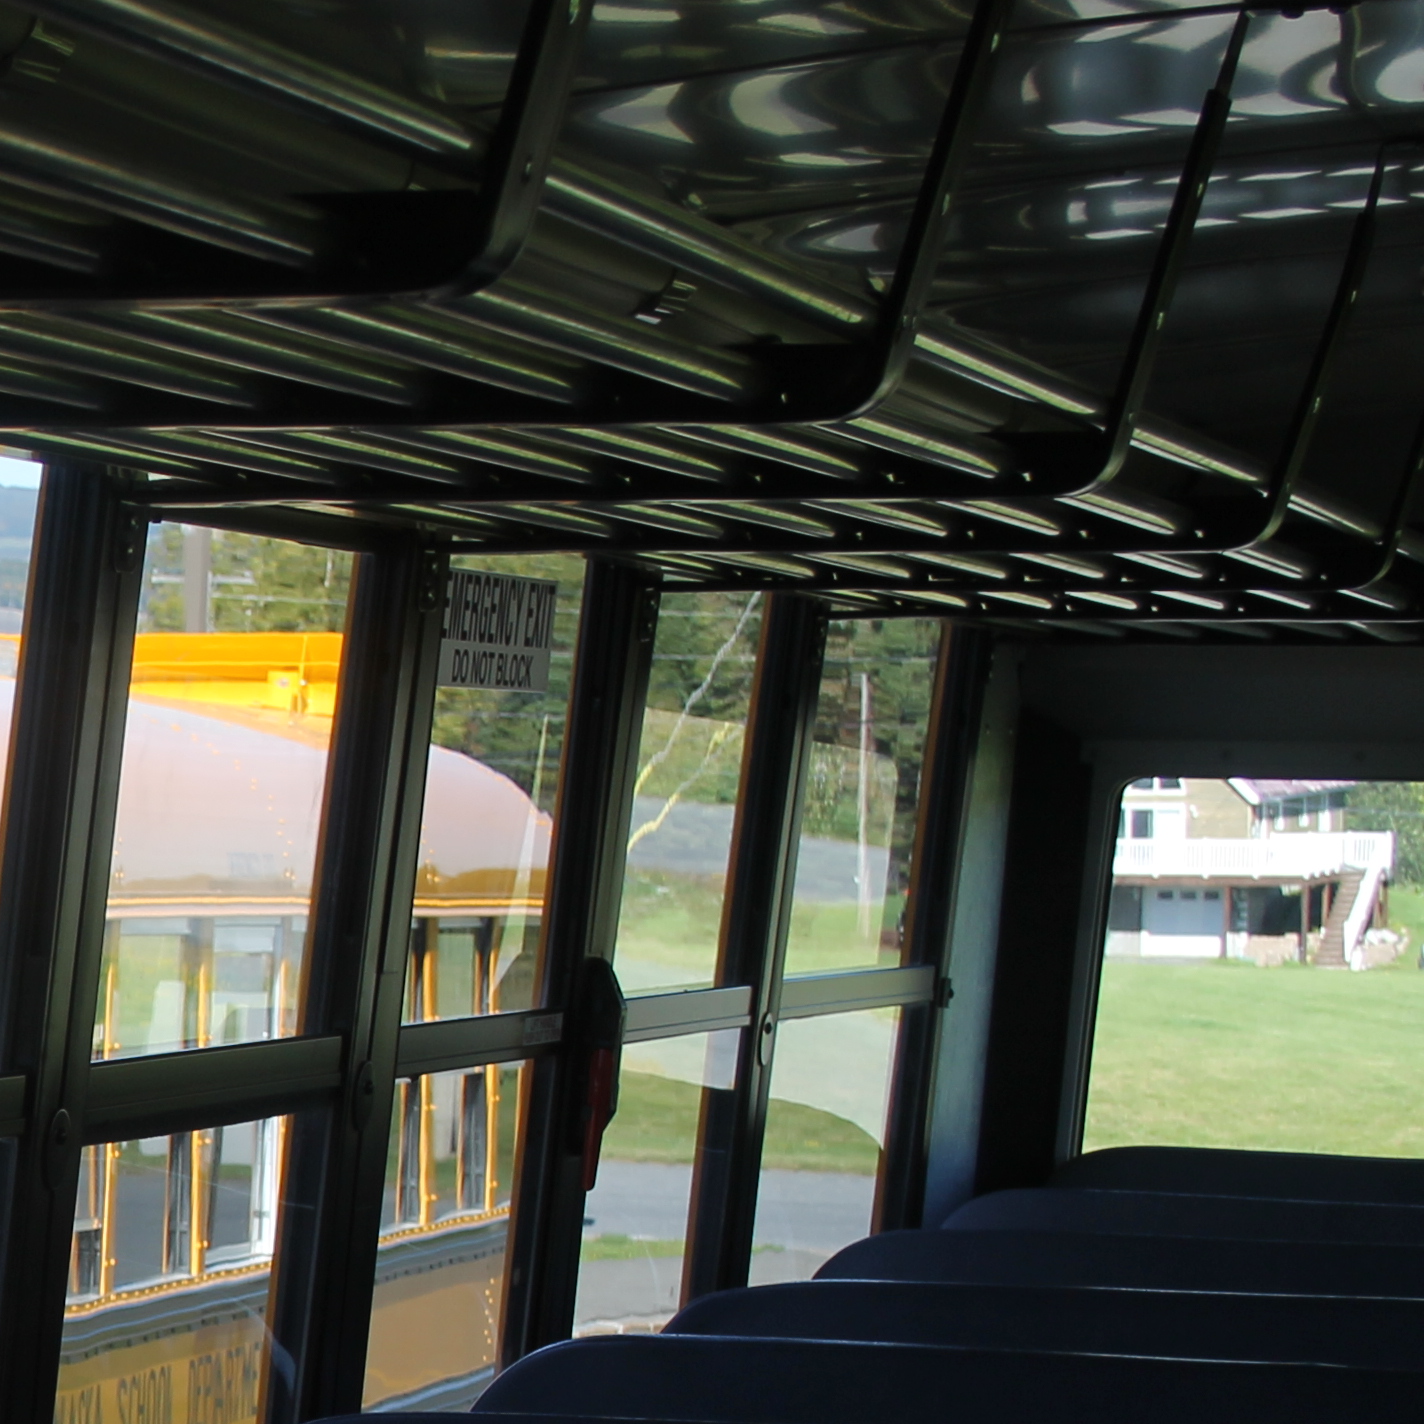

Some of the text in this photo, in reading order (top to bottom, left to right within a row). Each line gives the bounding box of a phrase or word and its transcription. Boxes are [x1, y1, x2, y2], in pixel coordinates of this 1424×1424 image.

[523, 583, 556, 648] EXIT
[451, 648, 533, 688] DO NOT BLOCK
